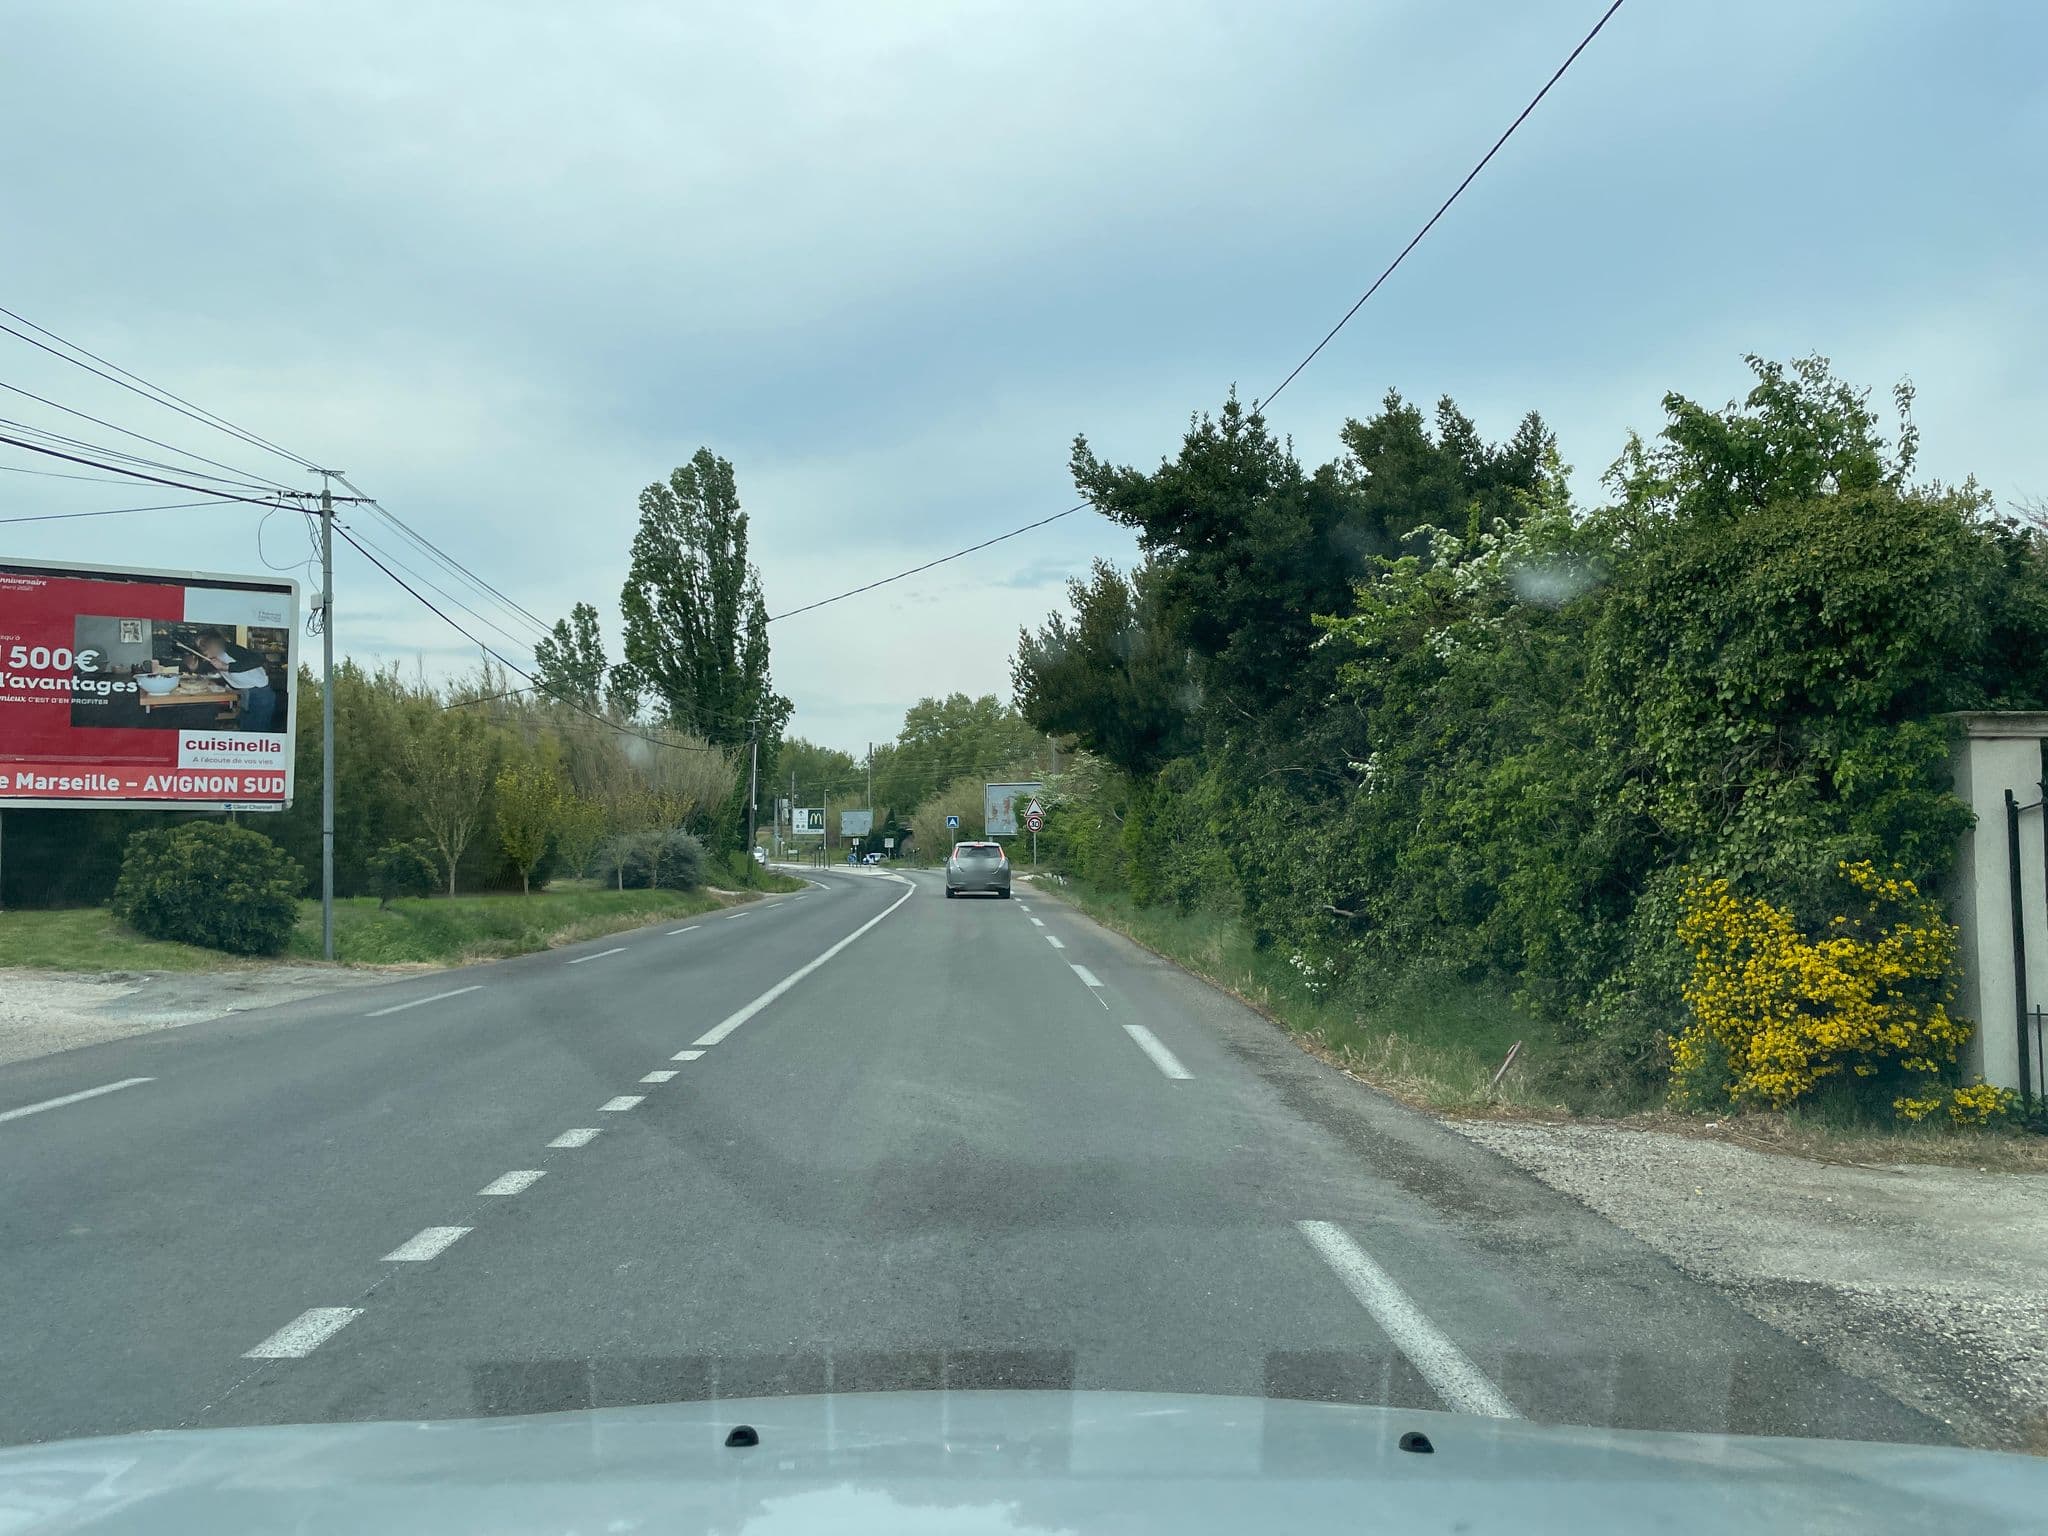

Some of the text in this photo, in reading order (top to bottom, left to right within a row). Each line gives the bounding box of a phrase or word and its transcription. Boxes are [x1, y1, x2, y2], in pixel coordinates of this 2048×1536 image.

[185, 738, 281, 753] cuisinella
[232, 756, 242, 764] de
[258, 758, 274, 766] vies
[16, 772, 120, 791] Marseille
[143, 774, 238, 793] AVIGNON
[243, 776, 285, 794] SUD
[1031, 820, 1040, 828] 30
